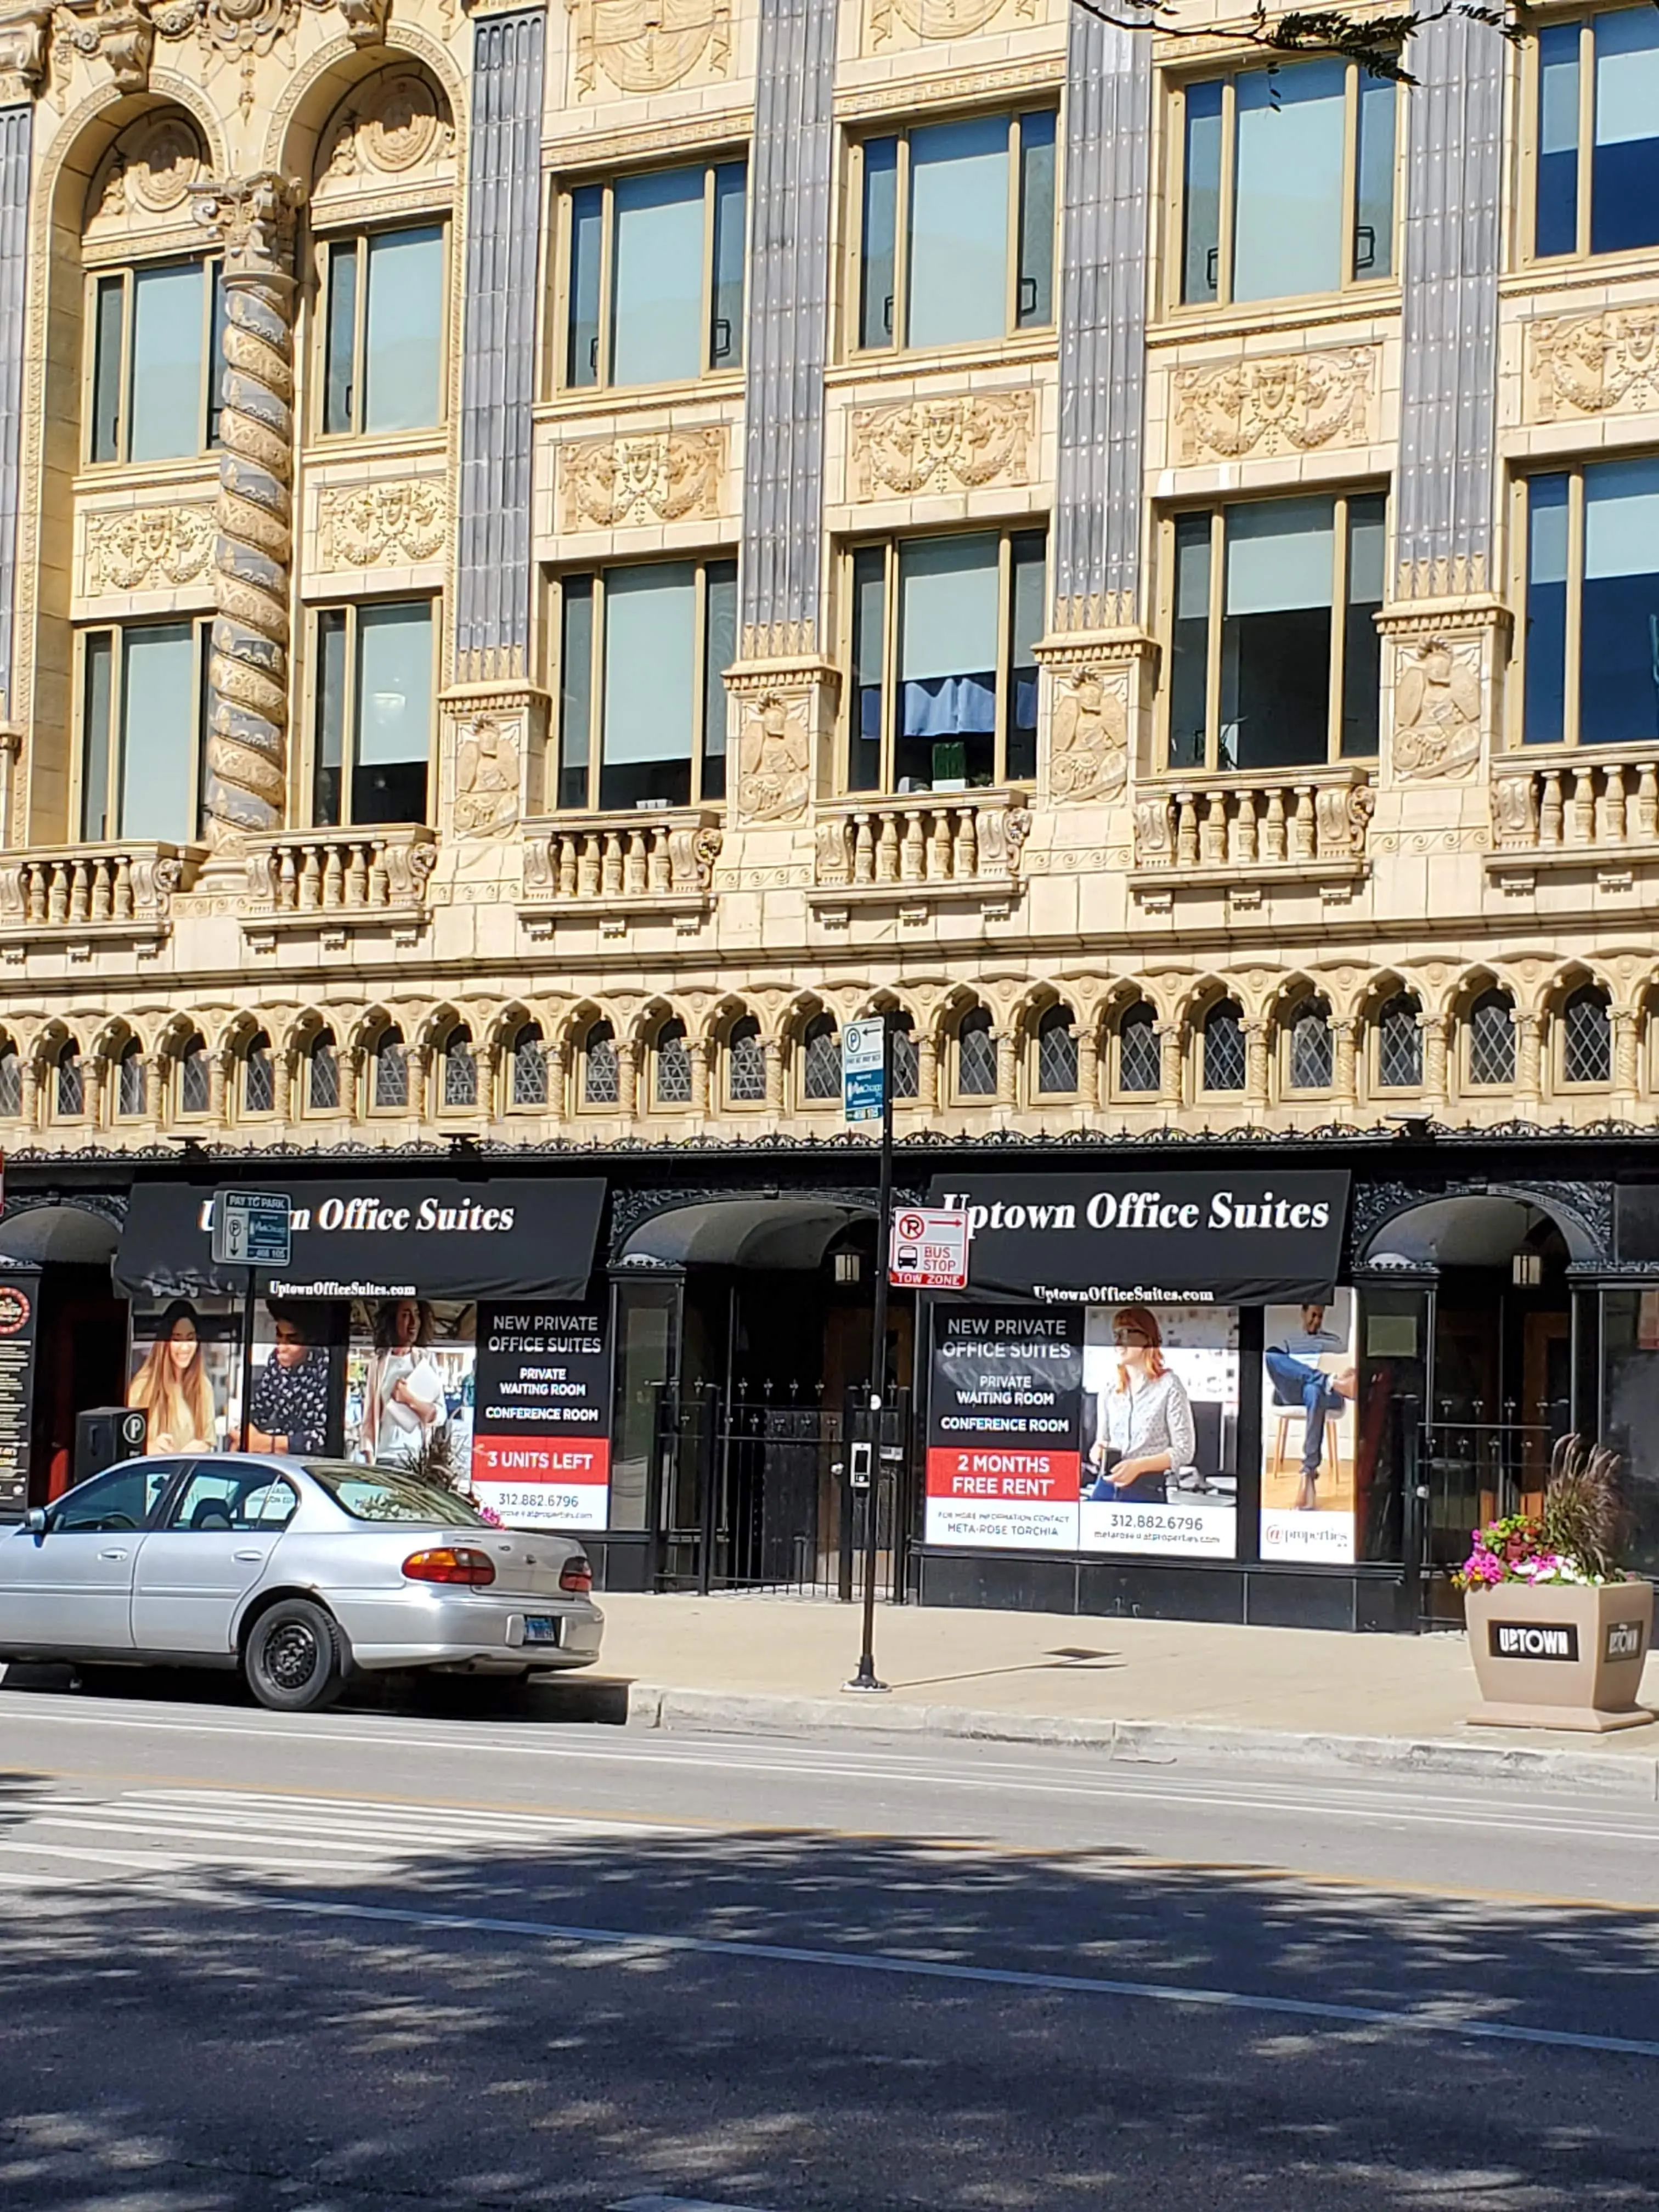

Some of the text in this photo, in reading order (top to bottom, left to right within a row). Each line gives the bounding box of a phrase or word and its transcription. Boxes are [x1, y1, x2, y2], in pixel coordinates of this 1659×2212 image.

[319, 1198, 411, 1231] Office
[415, 1198, 515, 1231] Suites
[1086, 1192, 1200, 1229] Office
[1208, 1192, 1330, 1229] Suites
[924, 1246, 950, 1259] BUS
[923, 1260, 956, 1272] STOP
[898, 1273, 960, 1285] TOW ZONE
[270, 1280, 416, 1298] UptownOfficeSuites.com
[1033, 1286, 1215, 1304] UptownOfficeSuites.com
[493, 1316, 598, 1331] NEW PRIVATE
[948, 1319, 1067, 1335] NEW PRIVATE
[488, 1336, 601, 1353] OFFICE SUITES
[943, 1342, 1071, 1359] OFFICE SUITES
[520, 1368, 566, 1380] PRIVATE
[499, 1383, 586, 1396] WAITING ROOM
[980, 1375, 1032, 1389] PRIVATE
[956, 1391, 1054, 1405] WAITING ROOM
[486, 1407, 599, 1421] CONFERENCE ROOM
[941, 1417, 1069, 1432] CONFERENCE ROOM
[501, 1452, 549, 1469] UNITS
[552, 1453, 594, 1470] LEFT
[957, 1454, 1050, 1474] 2 MONTHS
[952, 1476, 1055, 1496] FREE RENT
[499, 1493, 579, 1508] 312.882.6796
[1111, 1514, 1204, 1531] 312.882.6796
[1011, 1525, 1059, 1536] TORCHIA
[1499, 1627, 1568, 1655] UPTOWN
